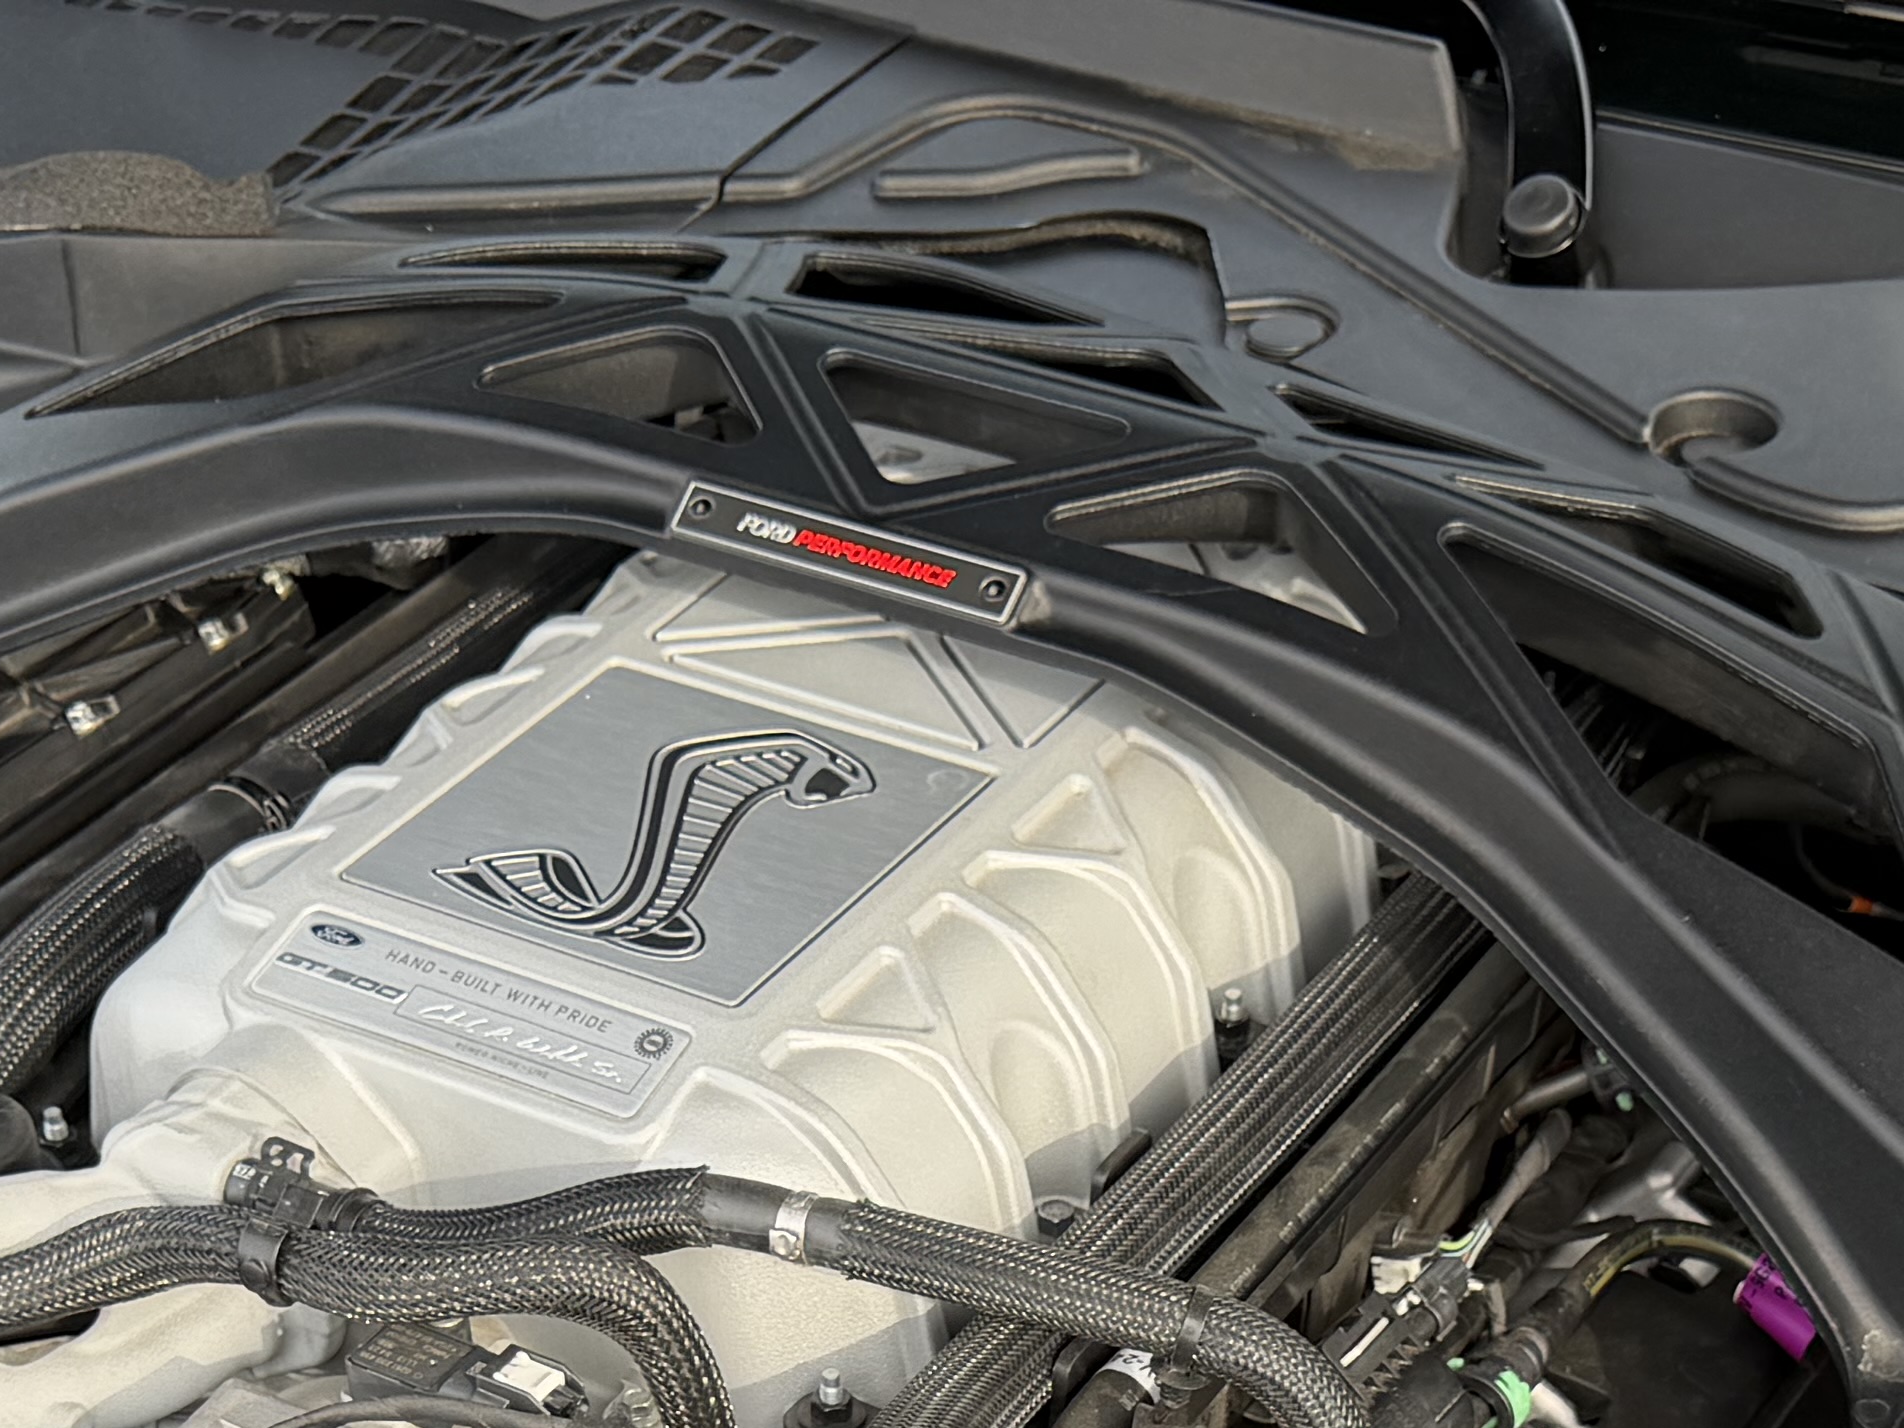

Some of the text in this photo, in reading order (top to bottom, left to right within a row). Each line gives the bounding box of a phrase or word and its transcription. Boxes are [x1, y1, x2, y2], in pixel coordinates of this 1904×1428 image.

[736, 512, 957, 590] FORD PERFORMANCE
[506, 986, 552, 1014] WITH
[554, 1004, 612, 1034] PRIDE
